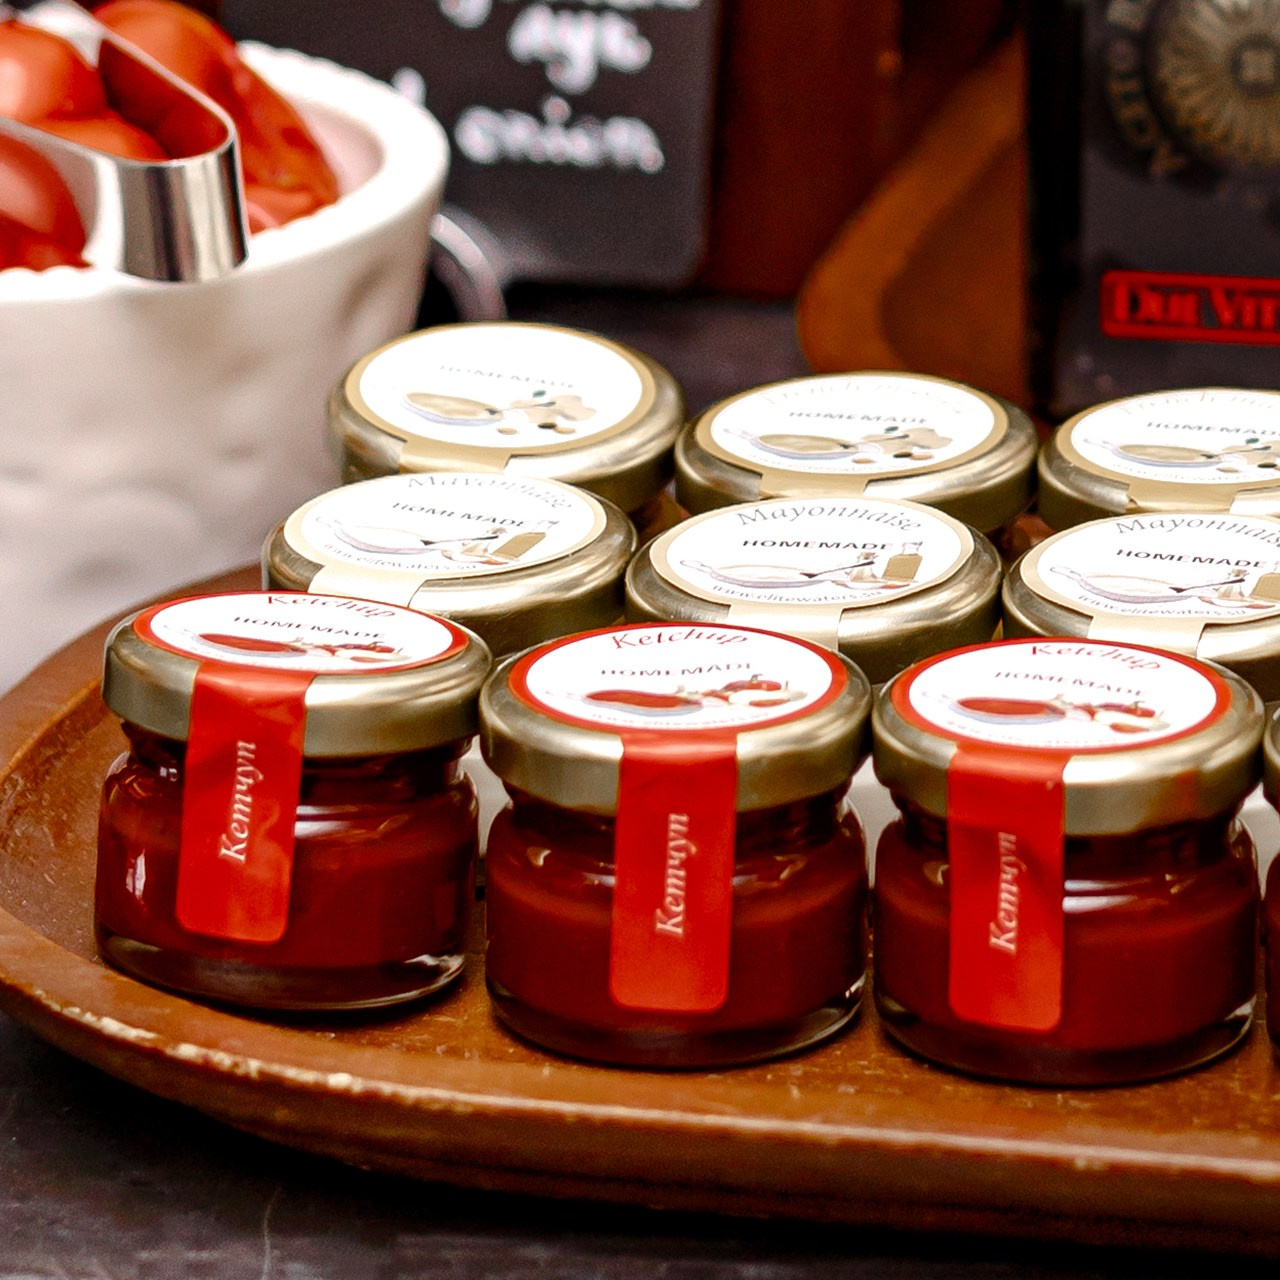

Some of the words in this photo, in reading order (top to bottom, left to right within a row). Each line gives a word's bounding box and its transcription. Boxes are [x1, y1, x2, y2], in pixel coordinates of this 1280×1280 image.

[787, 410, 928, 425] HOMEMADE
[391, 501, 527, 528] HOMEMADE
[736, 504, 923, 532] Mayonnaise
[741, 538, 894, 551] HOMEMADE
[1115, 548, 1267, 569] HOMEMADE
[267, 594, 397, 618] Ketchup
[233, 615, 387, 639] HOMEMADE
[610, 627, 749, 650] Ketchup
[600, 661, 756, 677] HOMEMADE
[1031, 644, 1162, 671] Ketchup
[994, 671, 1147, 697] HOMEMADE
[217, 739, 265, 865] Кетчуп
[654, 812, 698, 938] Кетчуп
[988, 831, 1028, 954] Кетчуп
